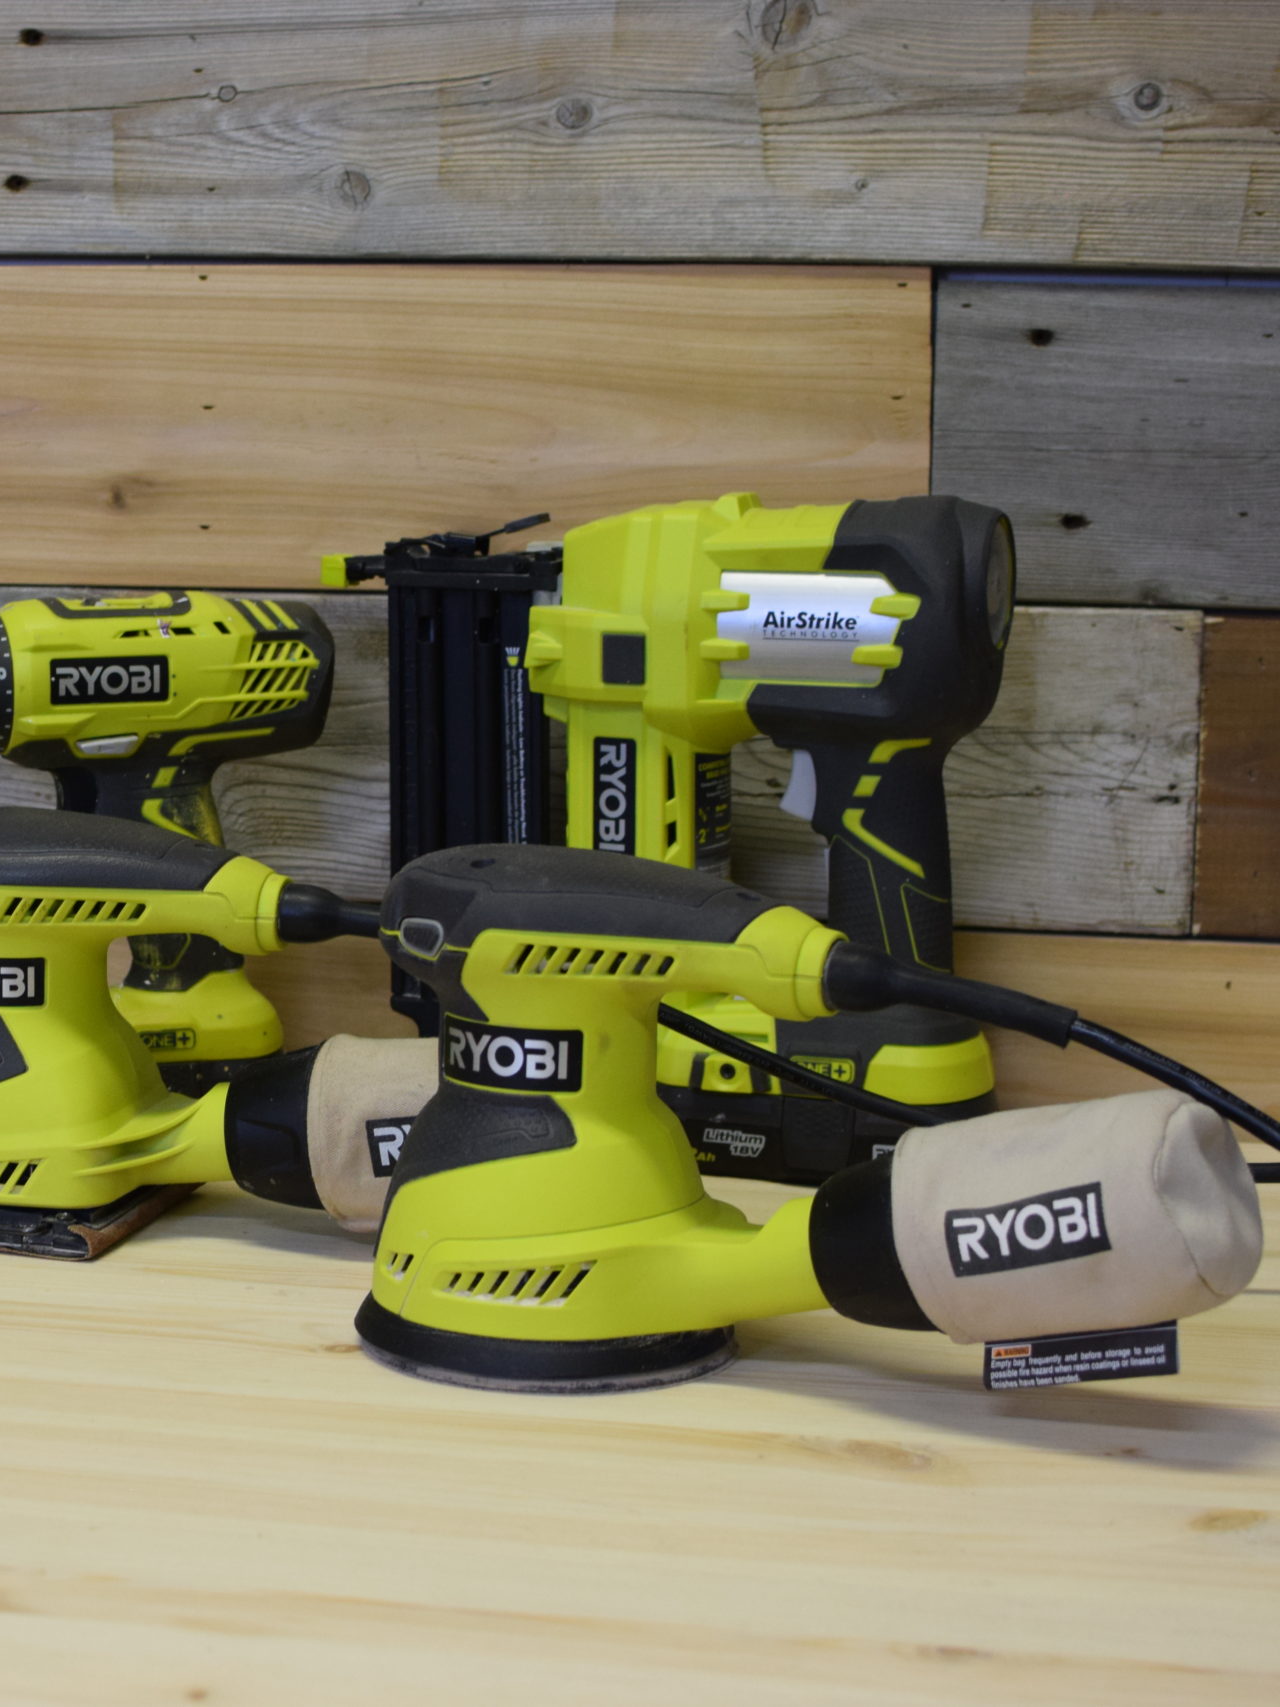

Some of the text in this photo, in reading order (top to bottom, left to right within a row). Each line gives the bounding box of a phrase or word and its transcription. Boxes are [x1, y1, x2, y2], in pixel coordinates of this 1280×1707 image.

[763, 611, 857, 630] AirStrike
[763, 630, 857, 638] TECHNOLOGY
[55, 664, 161, 697] RYOBI
[598, 743, 627, 852] RYOBI
[448, 1026, 569, 1080] RYOBI
[703, 1128, 765, 1145] Lithium
[730, 1144, 762, 1157] 18V
[952, 1192, 1100, 1262] RYOBI
[990, 1369, 1017, 1379] possible
[1019, 1368, 1030, 1376] fire
[1031, 1366, 1053, 1375] hazard
[1054, 1364, 1072, 1373] when
[1073, 1363, 1090, 1372] resin
[1091, 1360, 1120, 1371] coatings
[1156, 1355, 1166, 1364] oil
[991, 1360, 1012, 1369] Empty
[1013, 1359, 1026, 1368] bag
[1029, 1355, 1061, 1365] frequently
[1064, 1353, 1078, 1362] and
[1080, 1351, 1102, 1360] before
[1105, 1348, 1131, 1359] storage
[1144, 1344, 1165, 1354] avoid
[991, 1380, 1018, 1389] finishes
[1019, 1379, 1035, 1387] have
[1035, 1377, 1053, 1386] been
